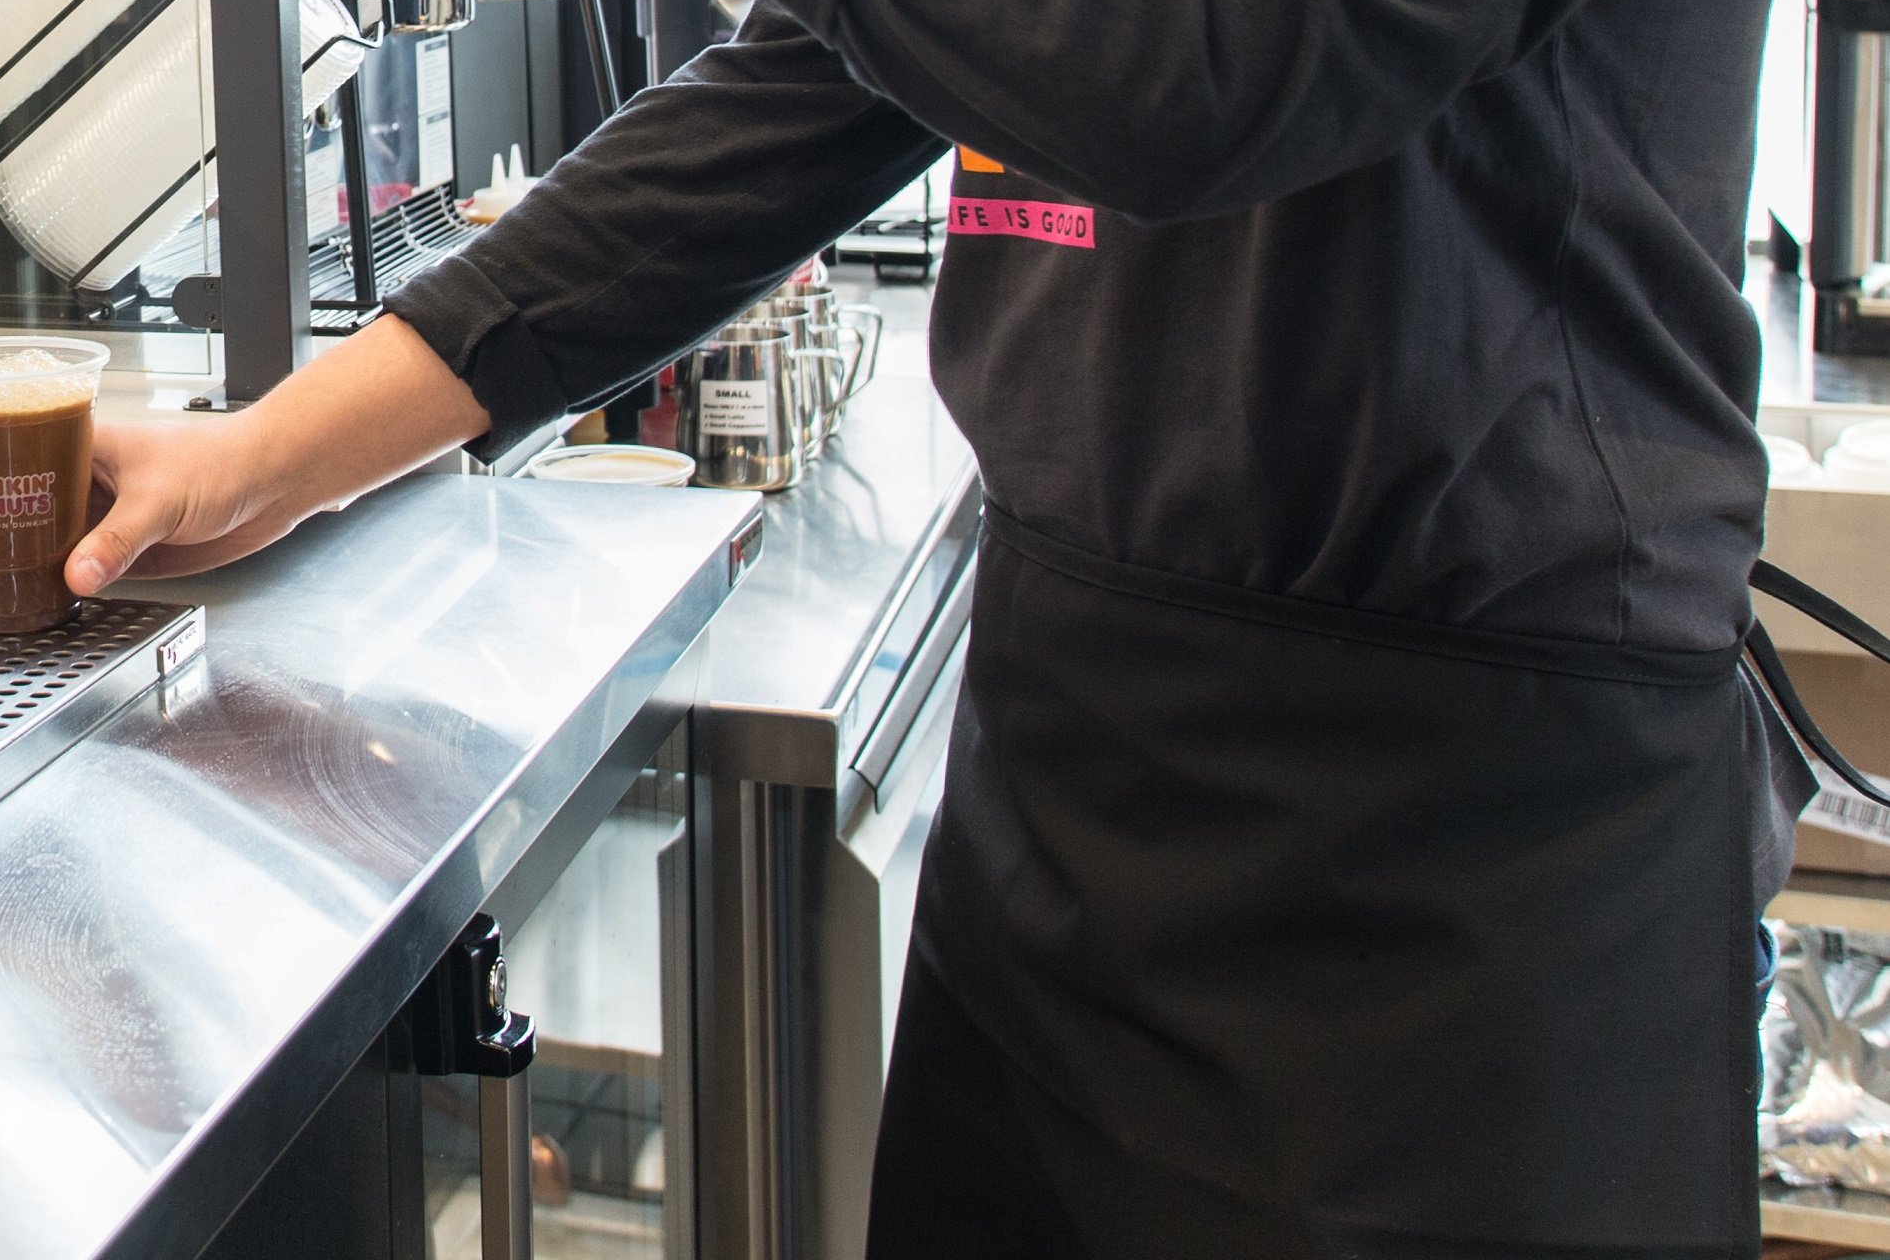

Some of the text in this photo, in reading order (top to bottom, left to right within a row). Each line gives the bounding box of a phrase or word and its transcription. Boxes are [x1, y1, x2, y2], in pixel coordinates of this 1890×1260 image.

[1004, 207, 1030, 229] IS
[1041, 210, 1087, 239] GOOD
[716, 390, 751, 398] SMALL
